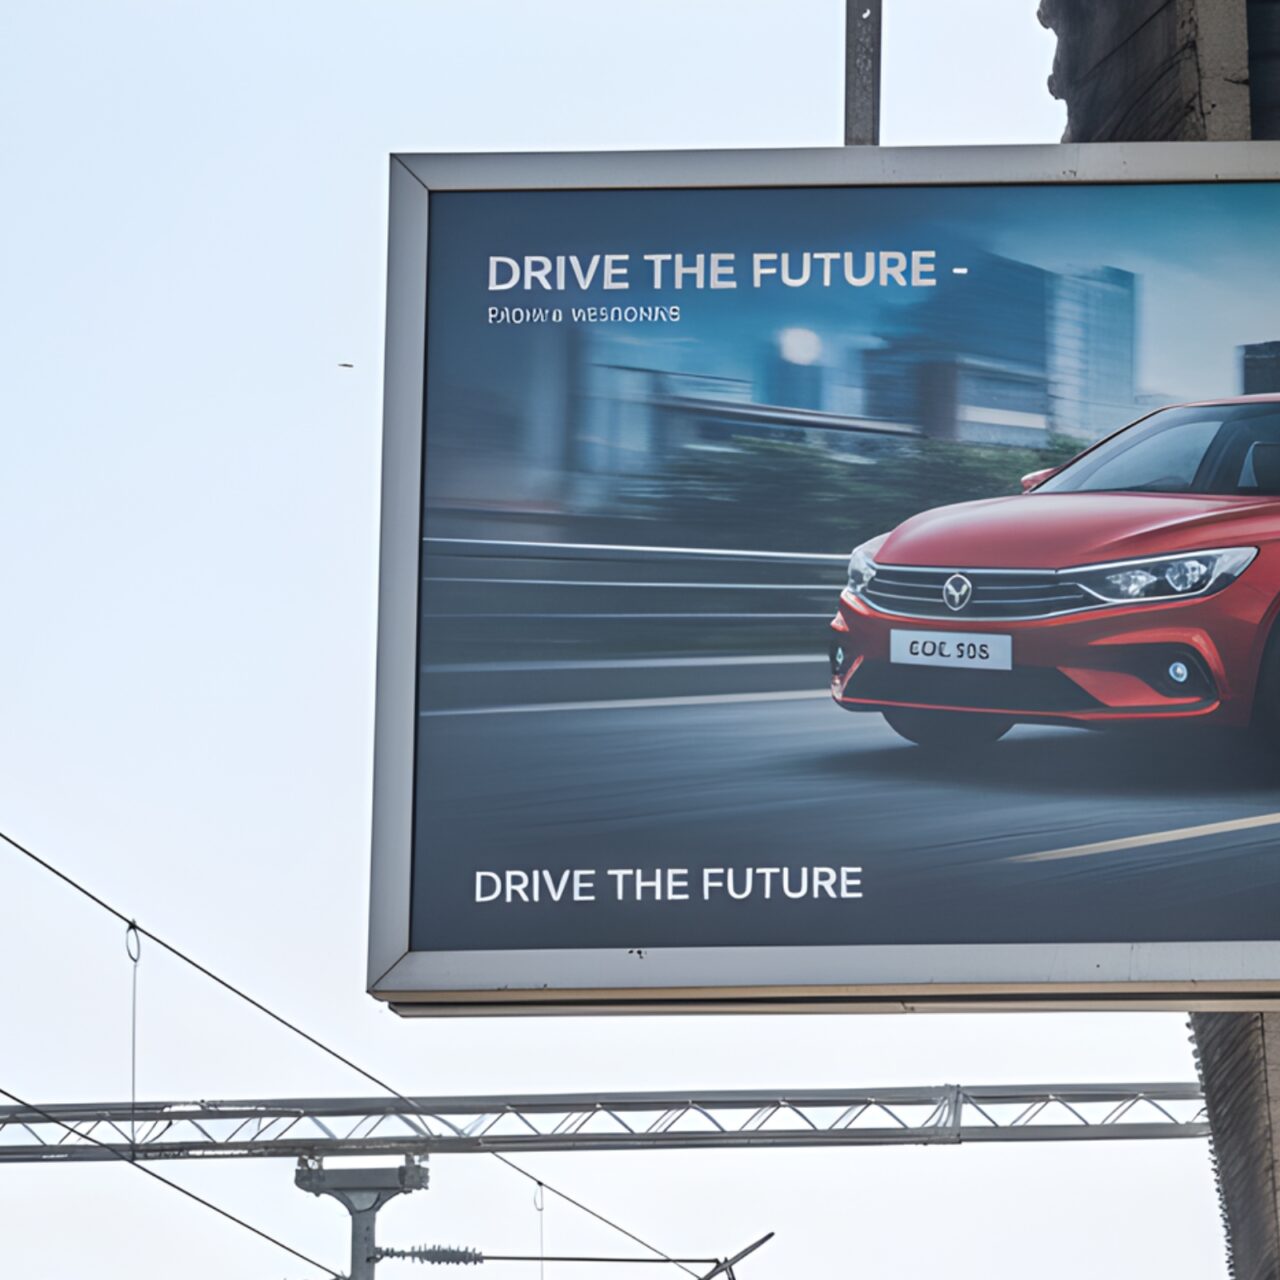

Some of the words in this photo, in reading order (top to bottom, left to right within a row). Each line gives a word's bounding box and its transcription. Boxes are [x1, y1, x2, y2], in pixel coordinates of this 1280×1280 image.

[487, 254, 630, 291] DRIVE
[643, 253, 738, 290] THE
[753, 250, 937, 288] FUTURE
[475, 869, 596, 903] DRIVE
[606, 868, 690, 901] THE
[703, 866, 863, 900] FUTURE
